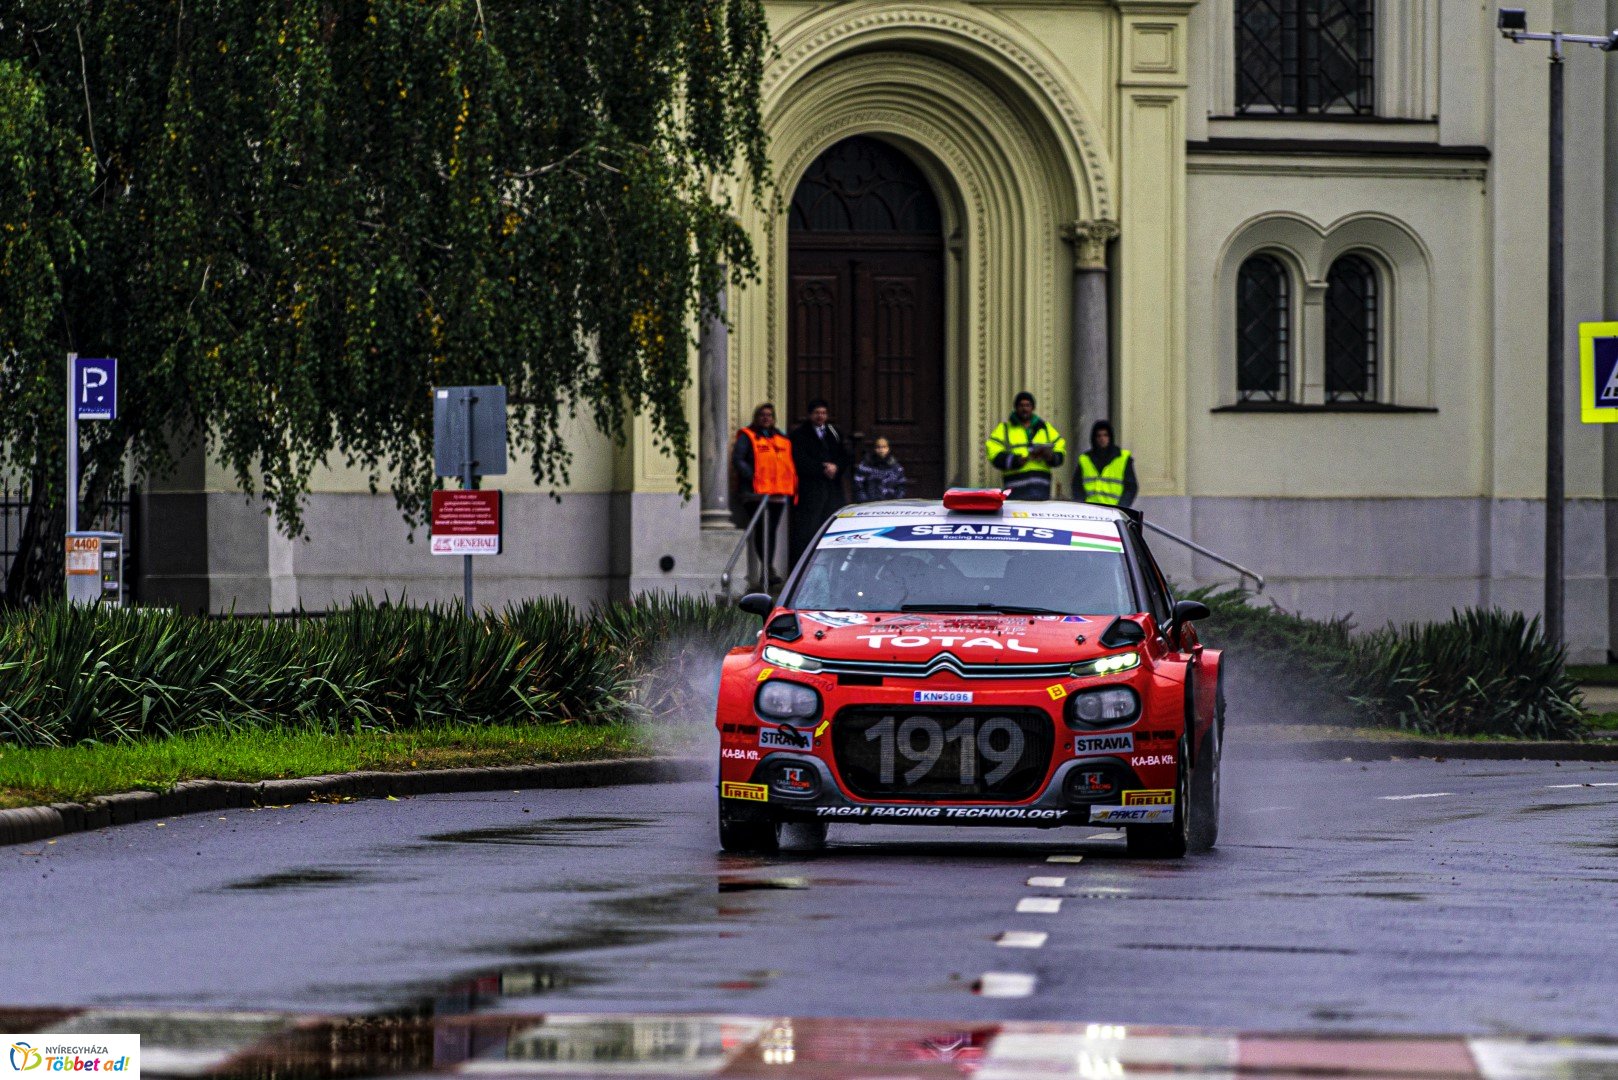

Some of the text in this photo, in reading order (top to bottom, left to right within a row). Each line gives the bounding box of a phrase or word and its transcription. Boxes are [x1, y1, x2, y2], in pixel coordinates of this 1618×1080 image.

[911, 525, 1054, 539] SEAJETS
[74, 539, 98, 549] 4400
[453, 538, 497, 548] GENERALI
[856, 634, 1039, 654] TOTAL
[1077, 736, 1132, 752] STRAVIA
[722, 748, 761, 760] KA-BA Kft.
[864, 715, 1025, 787] 1919
[1131, 754, 1177, 767] KA-BA Kft.
[724, 783, 765, 799] PIRELLI
[1125, 790, 1172, 806] PIRELLI
[871, 807, 941, 817] RACING
[946, 808, 1068, 819] TECHNOLOGY
[1108, 810, 1148, 819] PAKET
